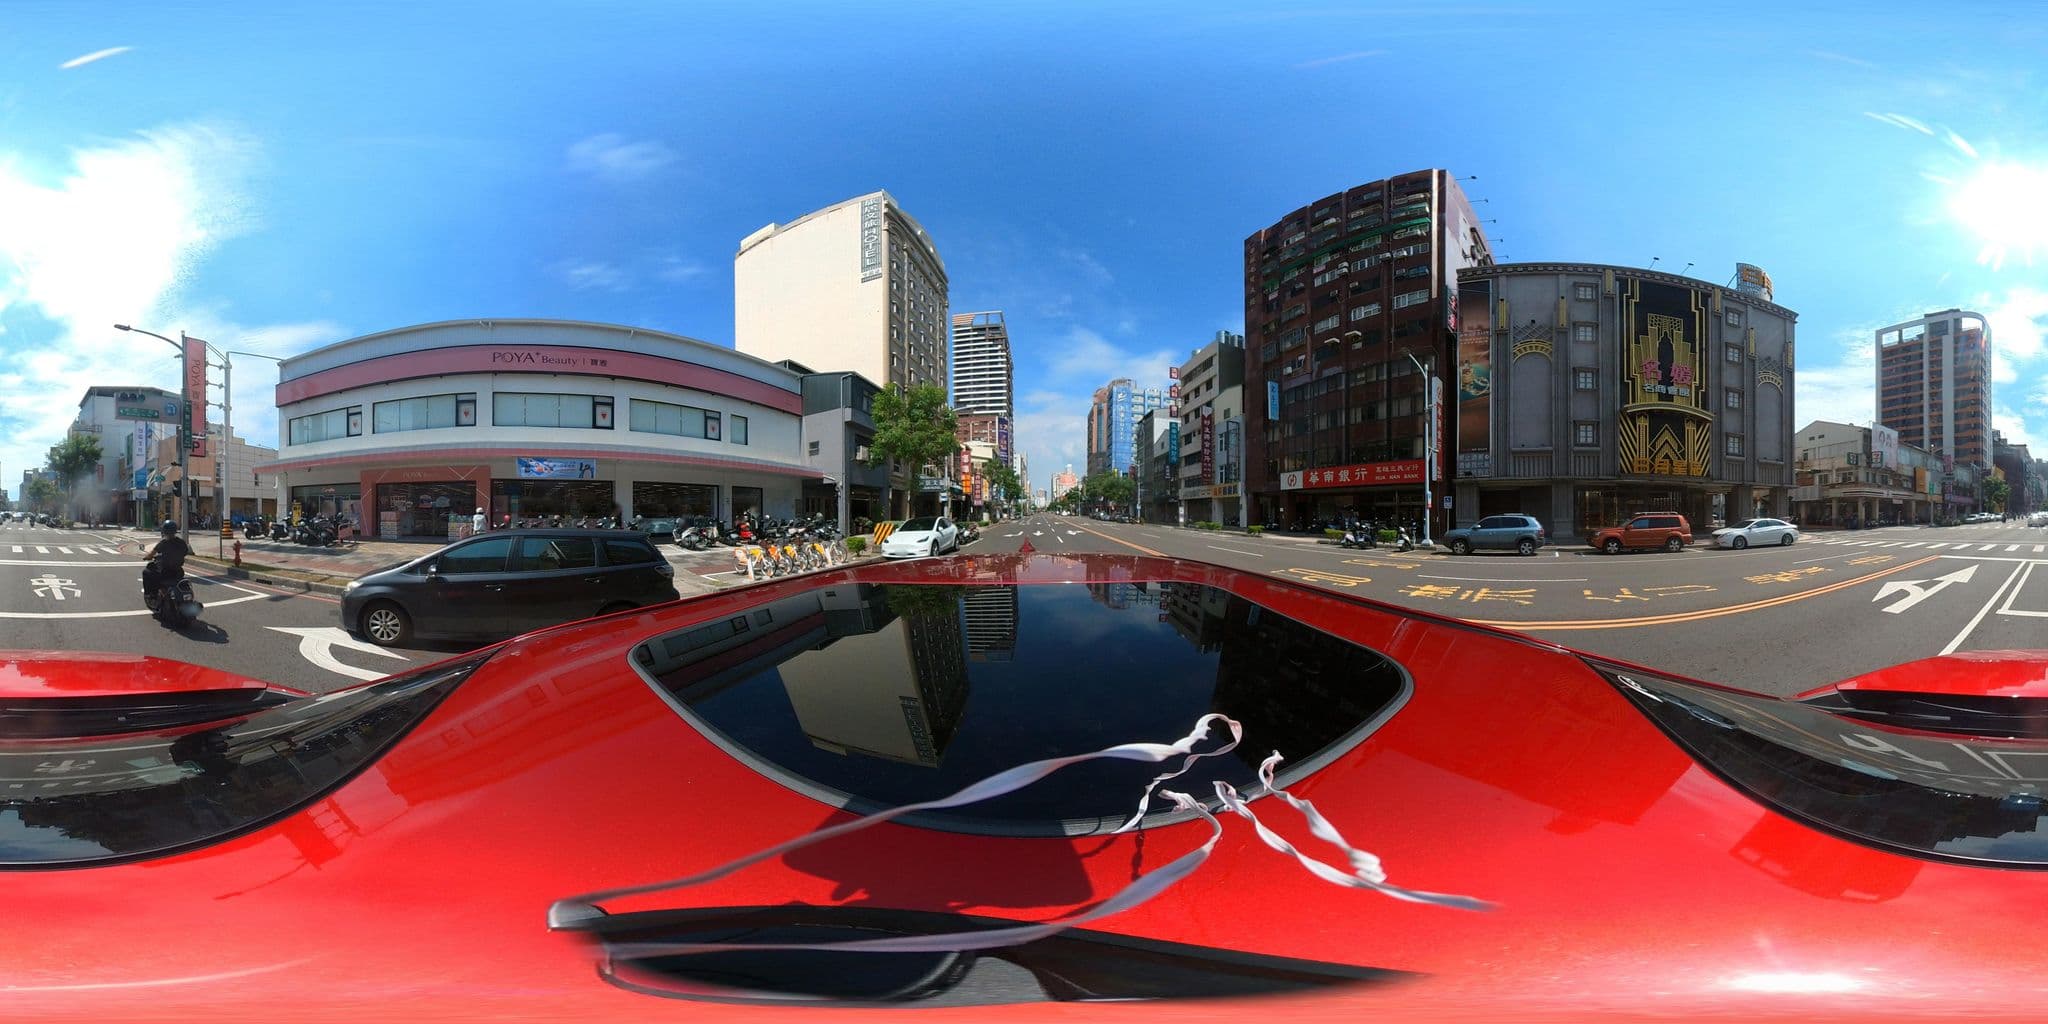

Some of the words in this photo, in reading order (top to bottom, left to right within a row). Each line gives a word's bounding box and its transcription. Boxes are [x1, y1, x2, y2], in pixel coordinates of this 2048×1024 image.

[541, 355, 578, 368] Beauty
[191, 359, 201, 387] POYA
[1308, 467, 1368, 486] 華南銀行
